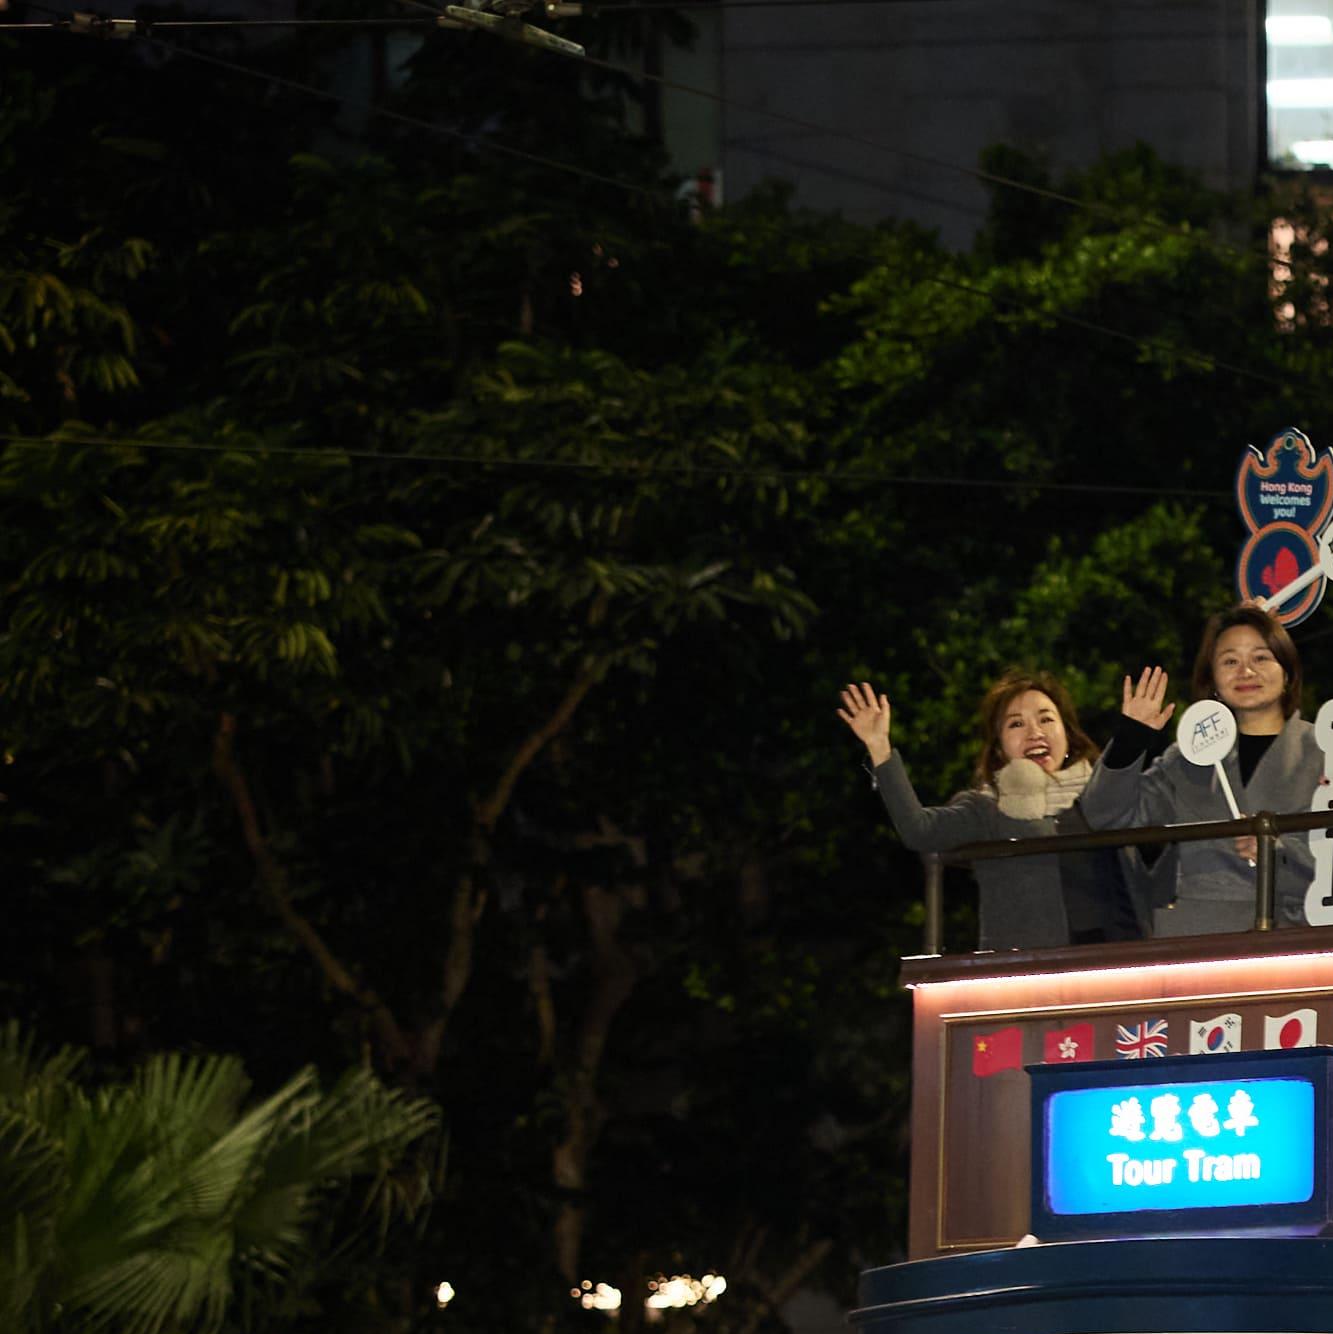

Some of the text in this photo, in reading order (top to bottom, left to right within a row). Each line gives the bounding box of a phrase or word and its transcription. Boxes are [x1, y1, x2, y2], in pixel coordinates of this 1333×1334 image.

[1260, 481, 1313, 496] Hong Kong
[1260, 494, 1311, 506] Welcomes
[1273, 507, 1297, 519] you!
[1106, 1149, 1261, 1187] Tour Tram
